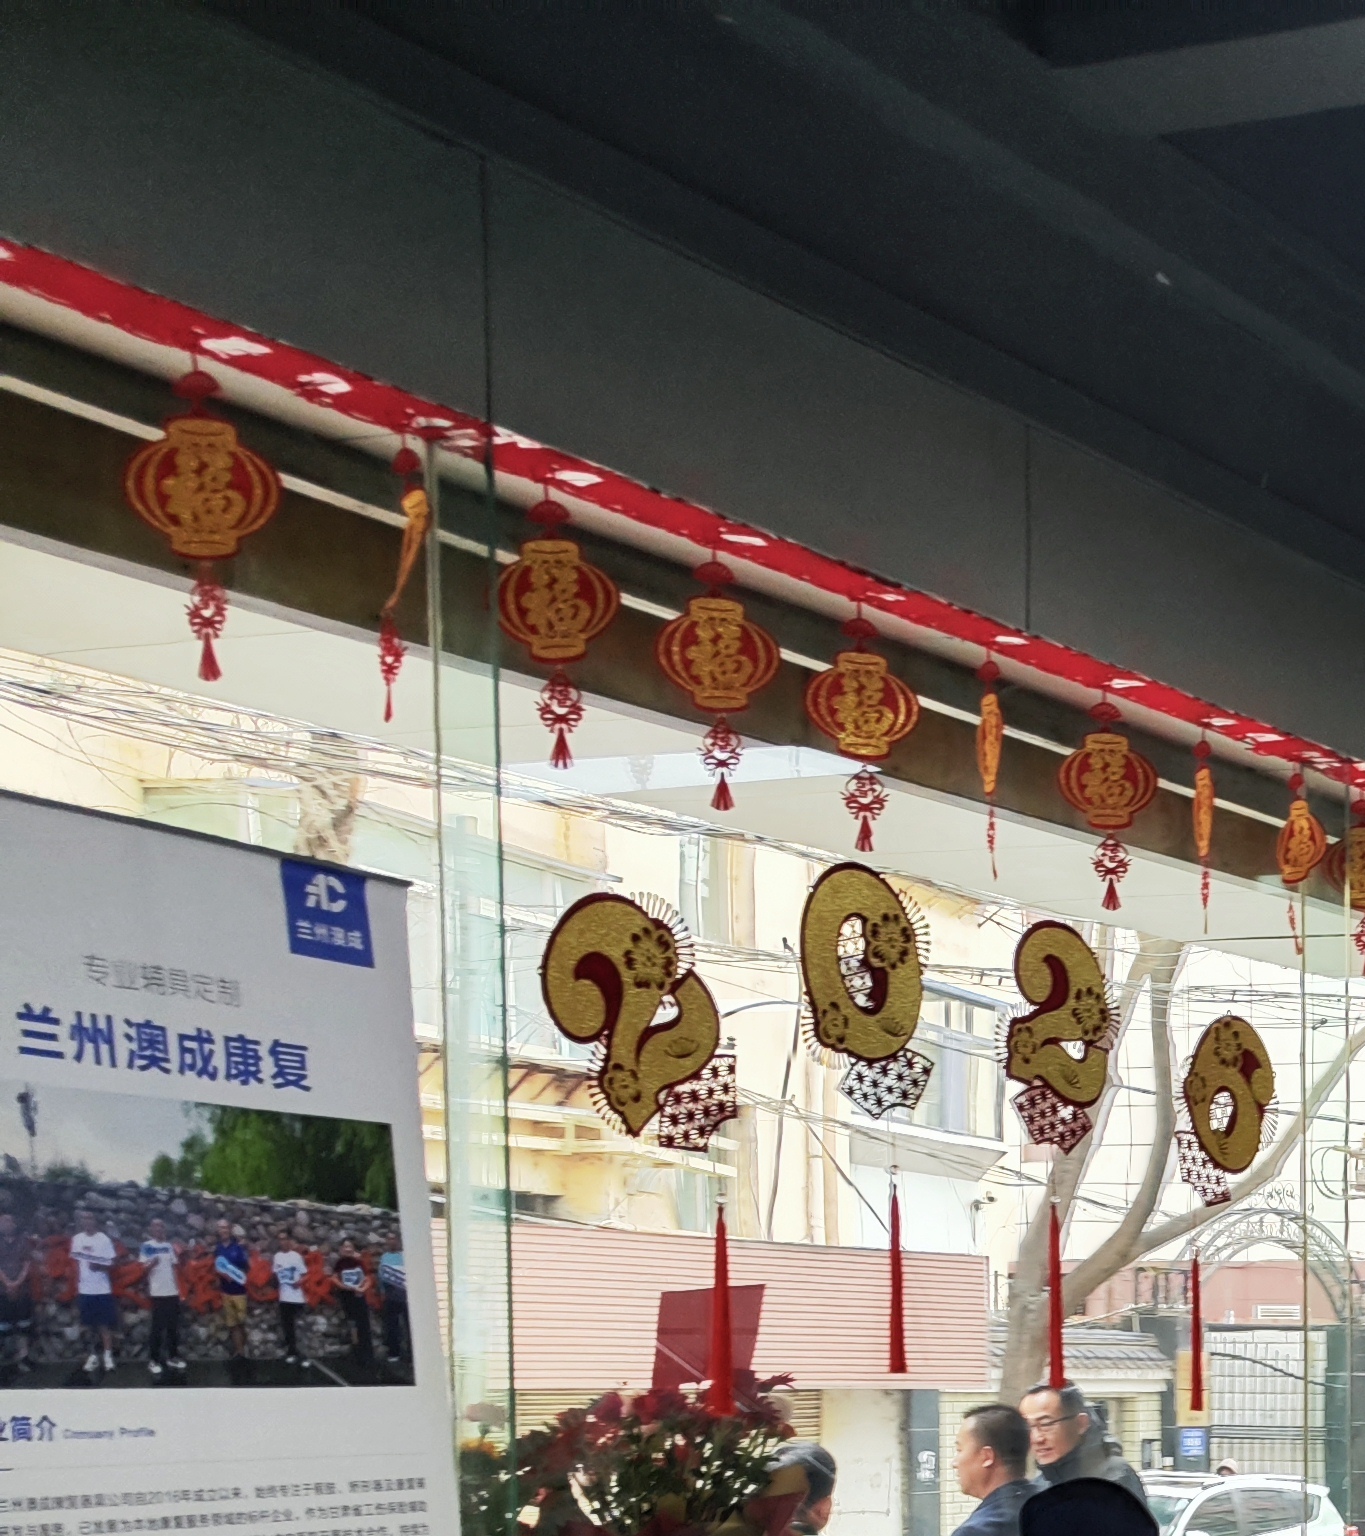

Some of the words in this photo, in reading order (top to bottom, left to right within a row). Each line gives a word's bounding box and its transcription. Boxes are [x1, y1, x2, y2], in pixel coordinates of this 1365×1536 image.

[15, 1002, 313, 1092] 兰州澳成康复
